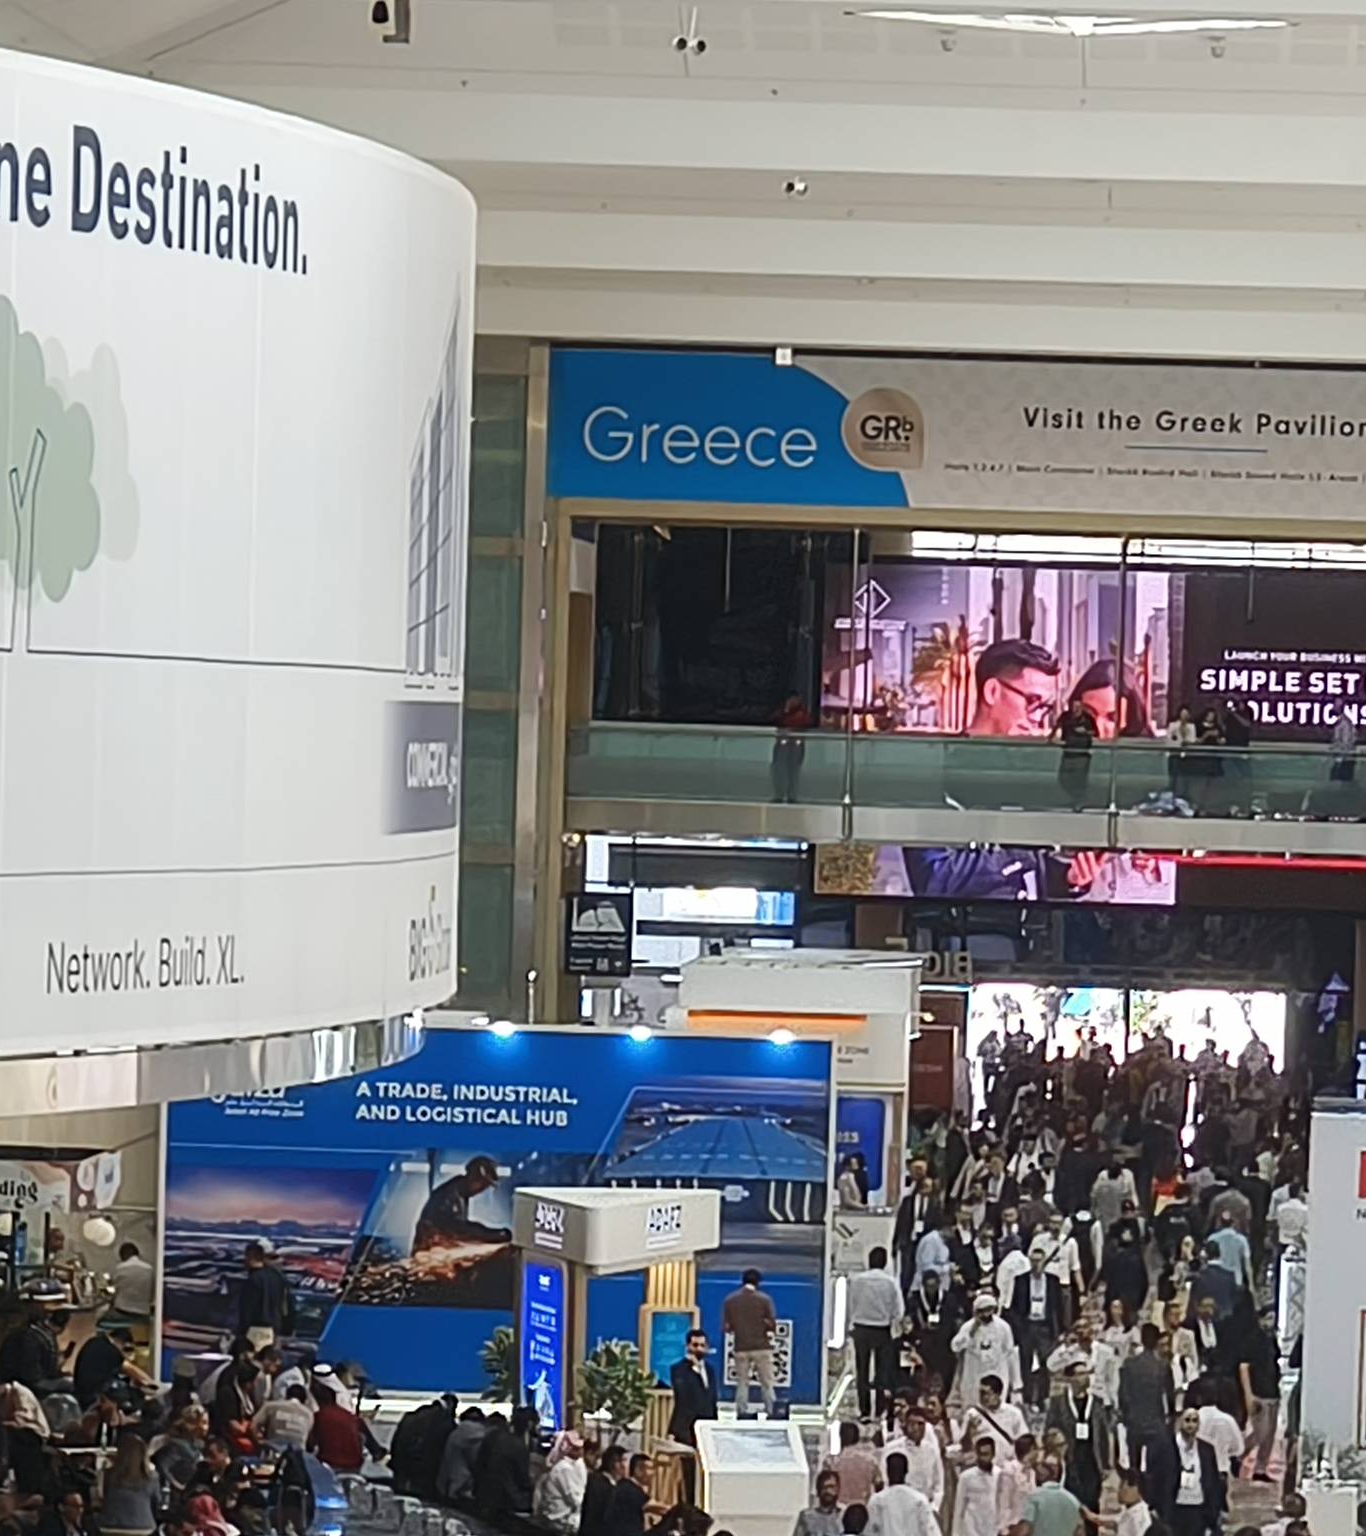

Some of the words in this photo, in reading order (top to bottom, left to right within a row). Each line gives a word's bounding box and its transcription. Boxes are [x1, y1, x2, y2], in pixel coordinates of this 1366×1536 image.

[71, 125, 308, 275] Destination.
[1023, 407, 1085, 431] Visit
[1097, 409, 1142, 431] the
[1156, 411, 1243, 434] Greek
[583, 405, 819, 469] Greece
[1200, 669, 1302, 692] SIMPLE
[1308, 672, 1361, 695] SET
[46, 939, 151, 995] Network.
[159, 936, 211, 988] Build.
[216, 933, 244, 984] XL.
[355, 1081, 373, 1098] A
[374, 1082, 448, 1102] TRADE,
[453, 1084, 579, 1107] INDUSTRIAL,
[355, 1104, 401, 1123] AND
[405, 1105, 523, 1125] LOGISTICAL
[527, 1108, 569, 1127] HUB
